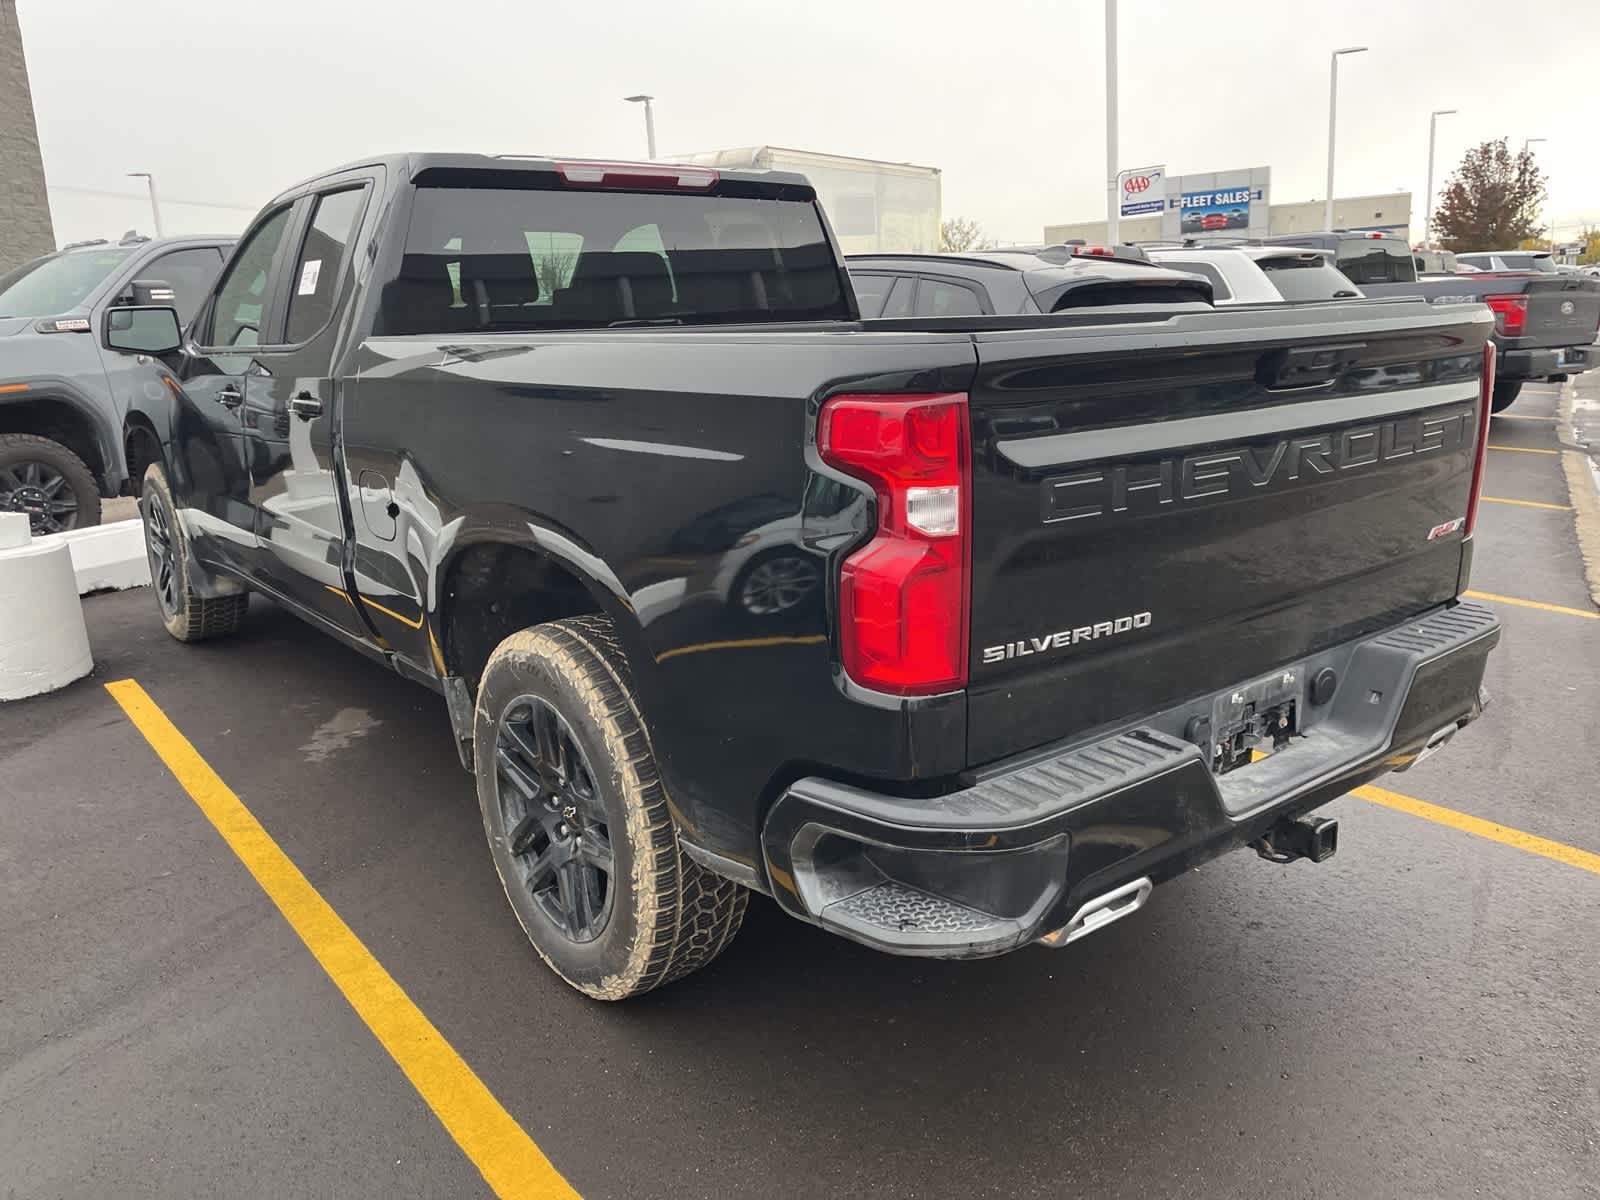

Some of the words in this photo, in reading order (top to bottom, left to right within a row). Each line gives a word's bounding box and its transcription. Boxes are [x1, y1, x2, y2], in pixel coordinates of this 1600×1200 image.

[1125, 177, 1149, 192] AAA
[1181, 194, 1213, 208] FLEET
[1215, 191, 1249, 205] SALES
[1041, 408, 1475, 524] CHEVROLET
[983, 611, 1151, 663] SILVERADO
